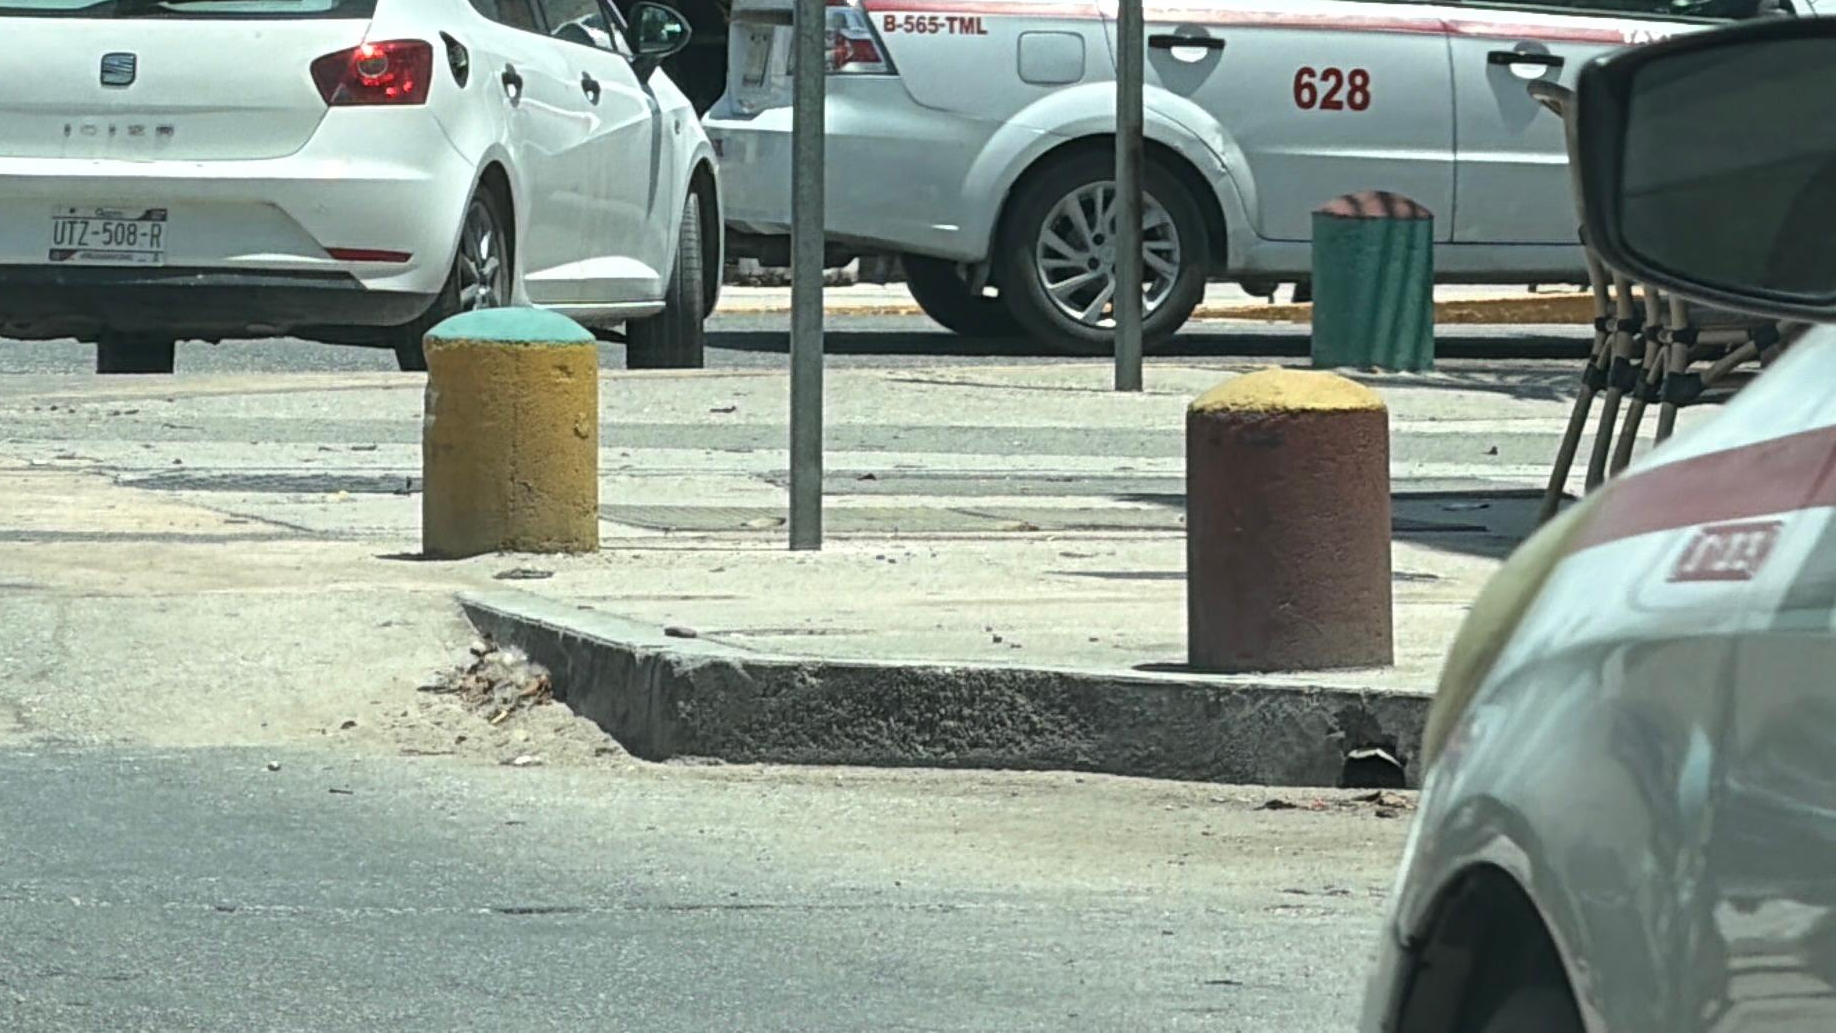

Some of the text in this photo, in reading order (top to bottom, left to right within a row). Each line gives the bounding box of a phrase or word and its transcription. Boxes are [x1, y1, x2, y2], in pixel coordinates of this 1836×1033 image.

[883, 14, 988, 35] B-565-TML
[1293, 66, 1371, 112] 628
[53, 220, 162, 248] UTZ-508-R
